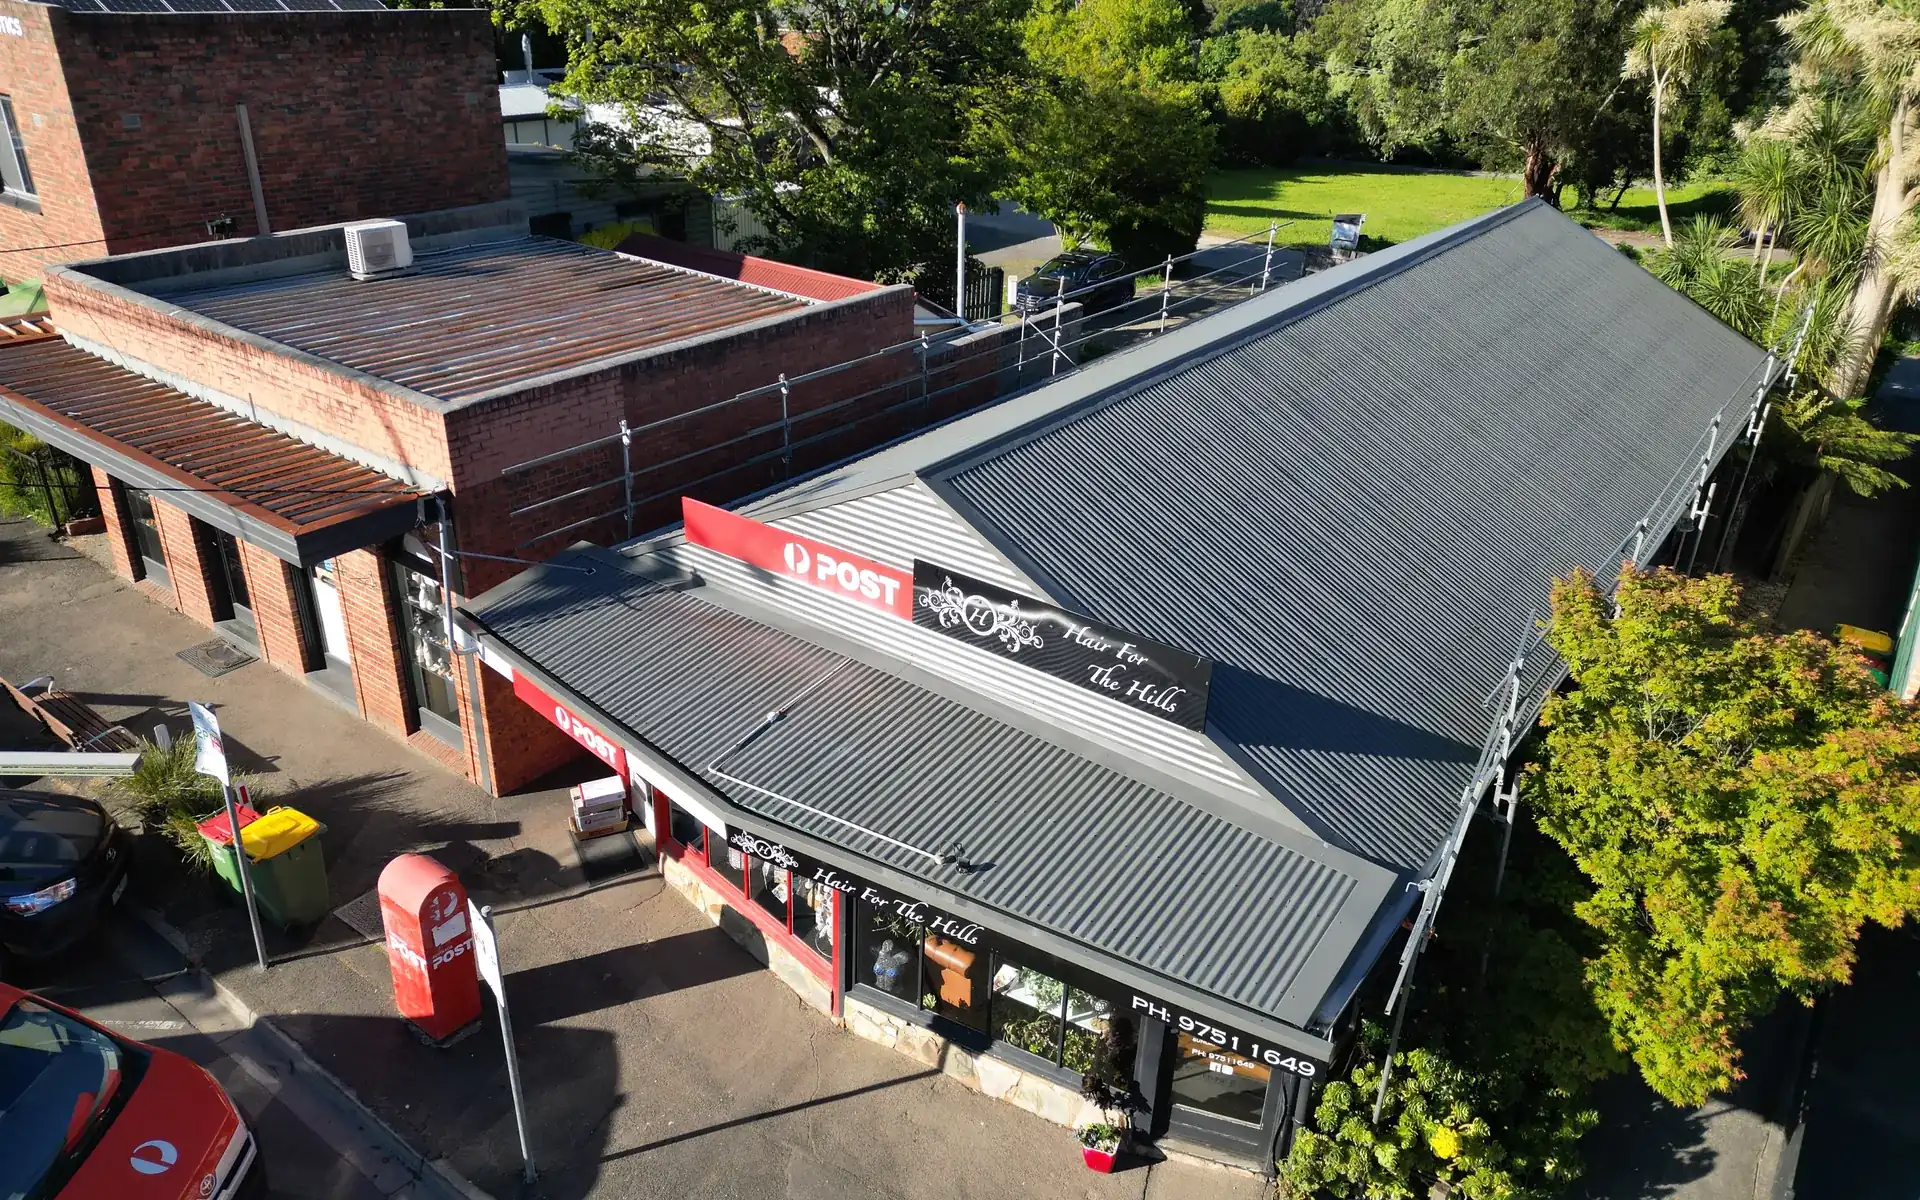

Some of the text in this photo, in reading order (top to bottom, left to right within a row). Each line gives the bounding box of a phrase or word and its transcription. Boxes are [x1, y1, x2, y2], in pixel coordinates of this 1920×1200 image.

[0, 15, 23, 37] TICS
[816, 552, 900, 606] POST
[1062, 622, 1149, 666] Hair For
[1087, 663, 1187, 713] The Hills
[571, 716, 617, 765] POST
[813, 867, 986, 946] Hair For The Hills
[389, 934, 427, 973] POST
[432, 938, 473, 970] POST
[1131, 995, 1171, 1023] PH:
[1251, 1043, 1316, 1077] 1649
